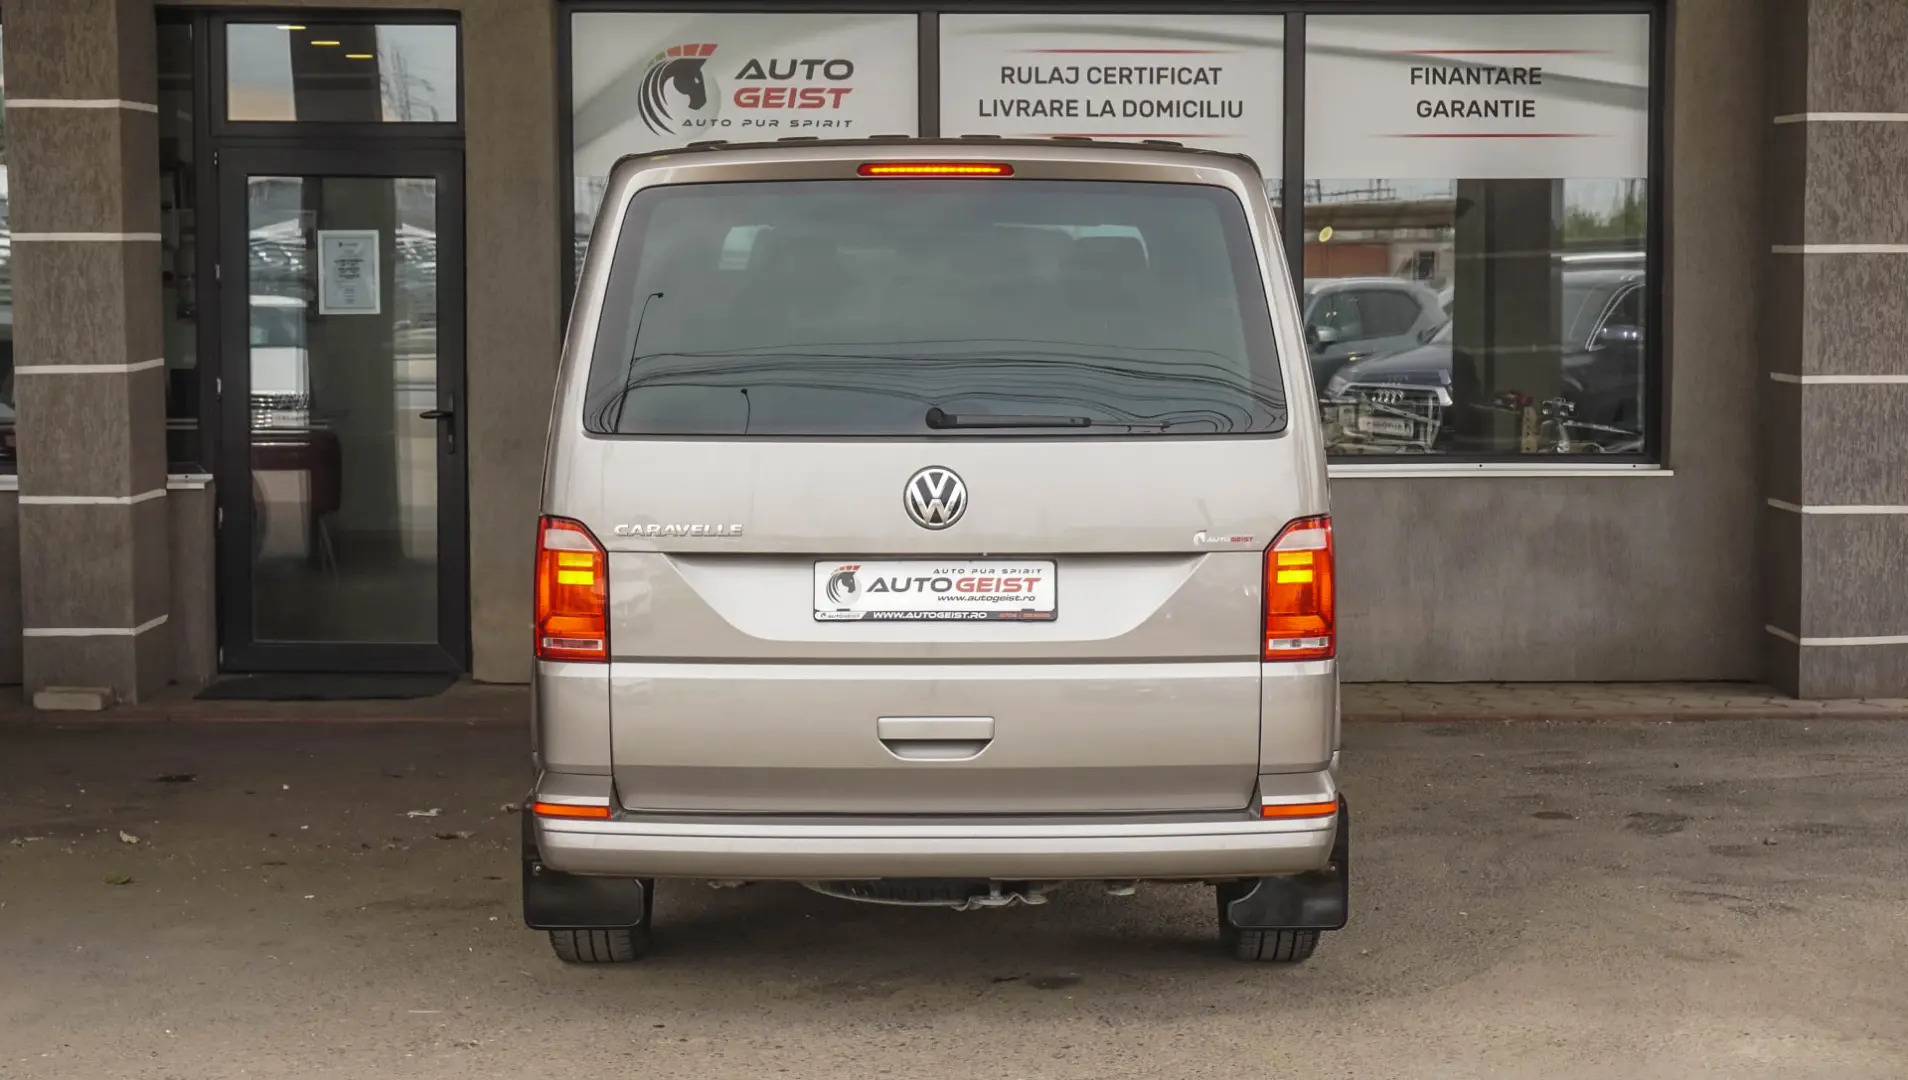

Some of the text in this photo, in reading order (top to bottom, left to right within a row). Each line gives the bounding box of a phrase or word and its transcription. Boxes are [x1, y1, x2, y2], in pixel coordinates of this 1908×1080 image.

[734, 58, 855, 81] AUTO
[1000, 66, 1223, 85] RULAJ CERTIFICAT
[1410, 67, 1543, 85] FINANTARE
[733, 87, 855, 109] GEIST
[978, 98, 1244, 118] LIVRARE LA DOMICILIU
[1416, 99, 1536, 118] GARANTIE
[681, 118, 854, 128] AUTO PUR SPIRIT
[906, 467, 966, 528] VW
[613, 523, 743, 538] CARAVELLE
[937, 594, 1036, 604] www.autogeist.ro
[872, 611, 988, 620] WWW.AUTOGEIST.RO
